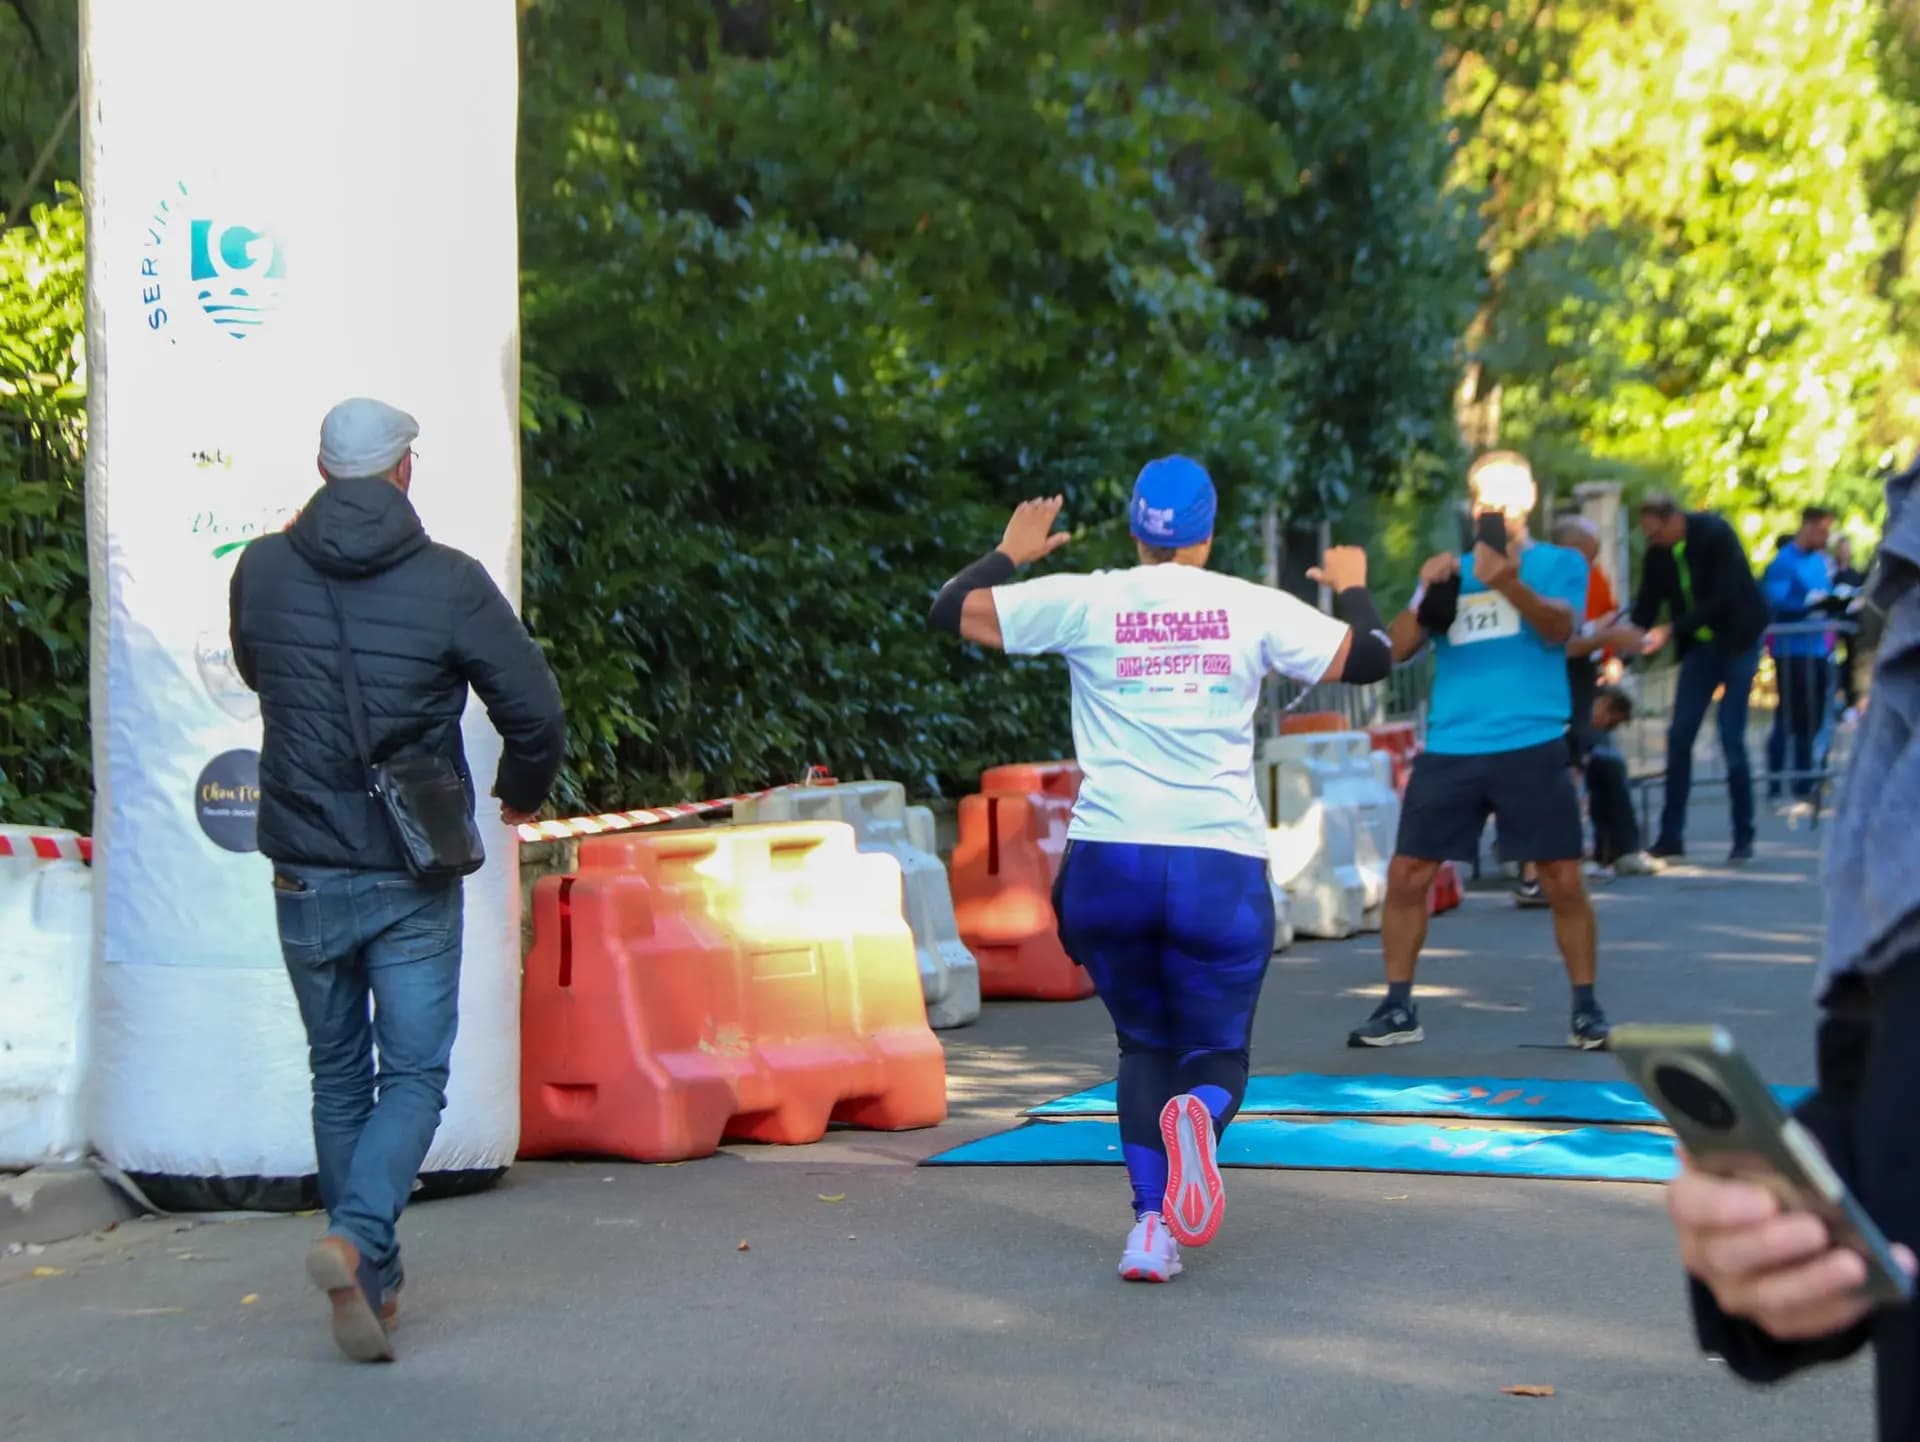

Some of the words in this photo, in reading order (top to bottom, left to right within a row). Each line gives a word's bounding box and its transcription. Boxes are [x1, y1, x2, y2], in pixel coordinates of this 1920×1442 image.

[1115, 611, 1147, 627] LES
[1464, 611, 1499, 632] 121
[1118, 658, 1142, 677] DIM
[1145, 656, 1161, 676] 25
[1163, 655, 1201, 675] SEPT
[1204, 656, 1231, 674] 2022
